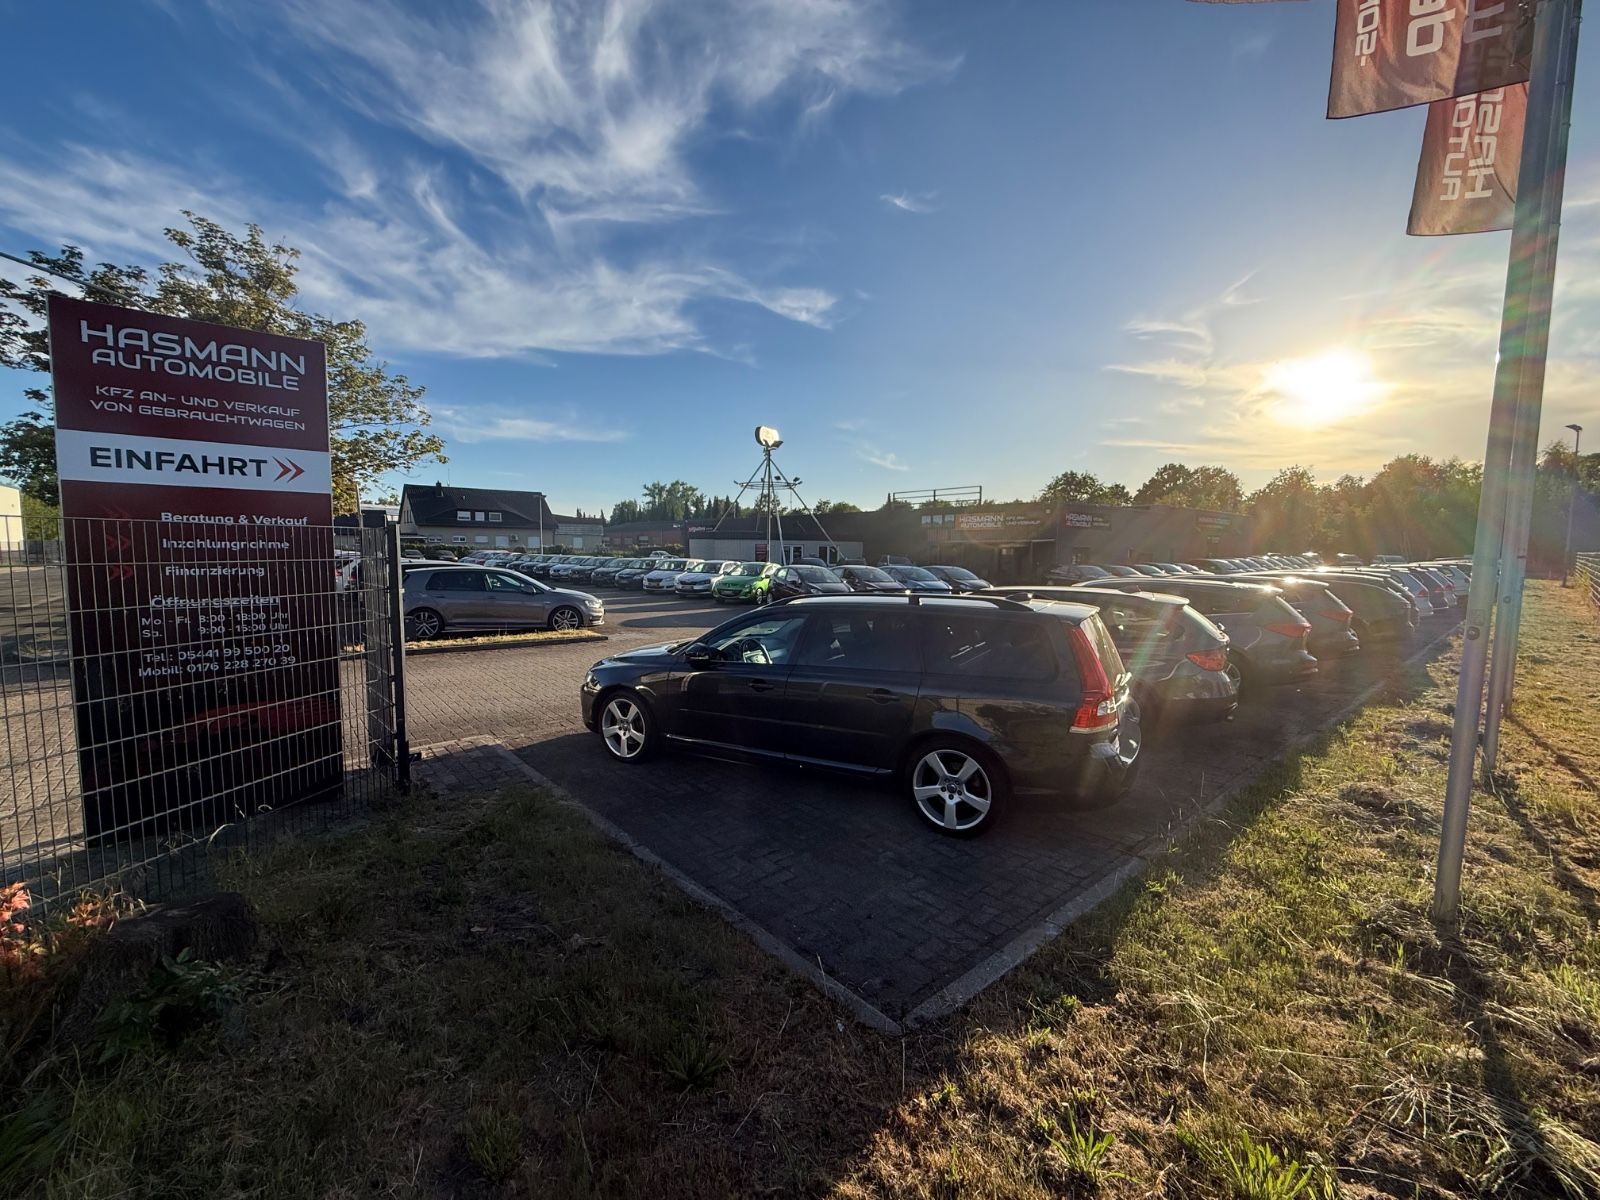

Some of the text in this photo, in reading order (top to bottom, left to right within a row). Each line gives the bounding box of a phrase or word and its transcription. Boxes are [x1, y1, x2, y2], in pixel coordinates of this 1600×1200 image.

[80, 319, 306, 375] HASMANN
[92, 349, 300, 391] AUTOMOBILE
[95, 385, 301, 417] KFZ AN- UND VERKAUF
[90, 400, 306, 431] VON GEBRAUCHTWAGEN
[89, 446, 268, 477] EINFAHRT
[160, 512, 309, 526] Beratung & Verkauf
[165, 565, 265, 577] Finanzierung
[270, 622, 289, 631] Uhr
[223, 647, 241, 657] 99
[245, 646, 270, 656] 500
[274, 644, 291, 653] 20
[187, 662, 220, 673] 0176
